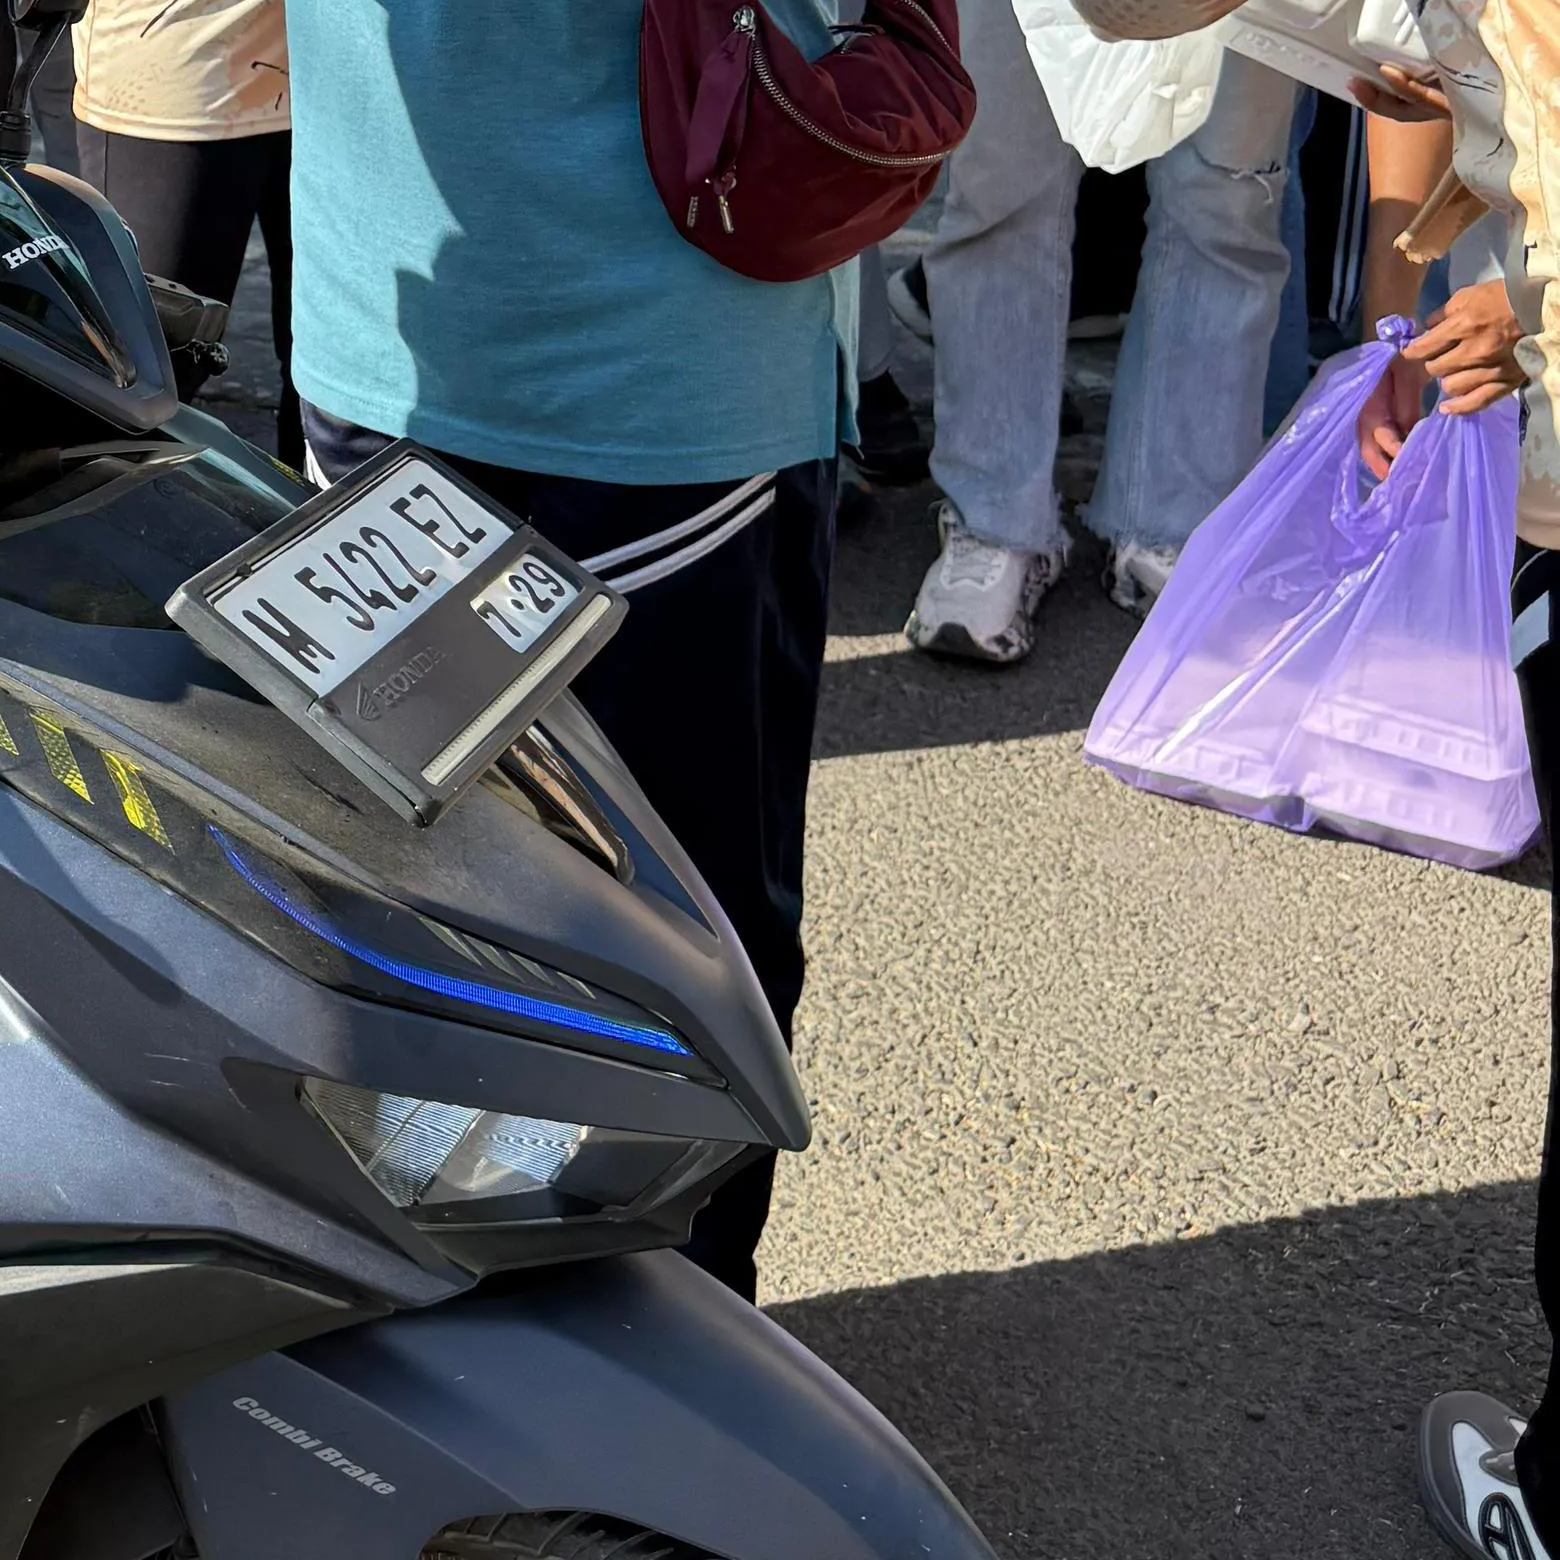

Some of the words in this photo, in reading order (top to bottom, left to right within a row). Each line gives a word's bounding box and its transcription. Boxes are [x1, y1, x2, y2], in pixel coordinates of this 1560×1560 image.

[242, 596, 336, 675] M
[293, 525, 436, 632] 5422
[389, 482, 488, 559] EZ
[372, 645, 449, 706] HONDA
[232, 1396, 323, 1450] Combi
[312, 1447, 397, 1495] Brake
